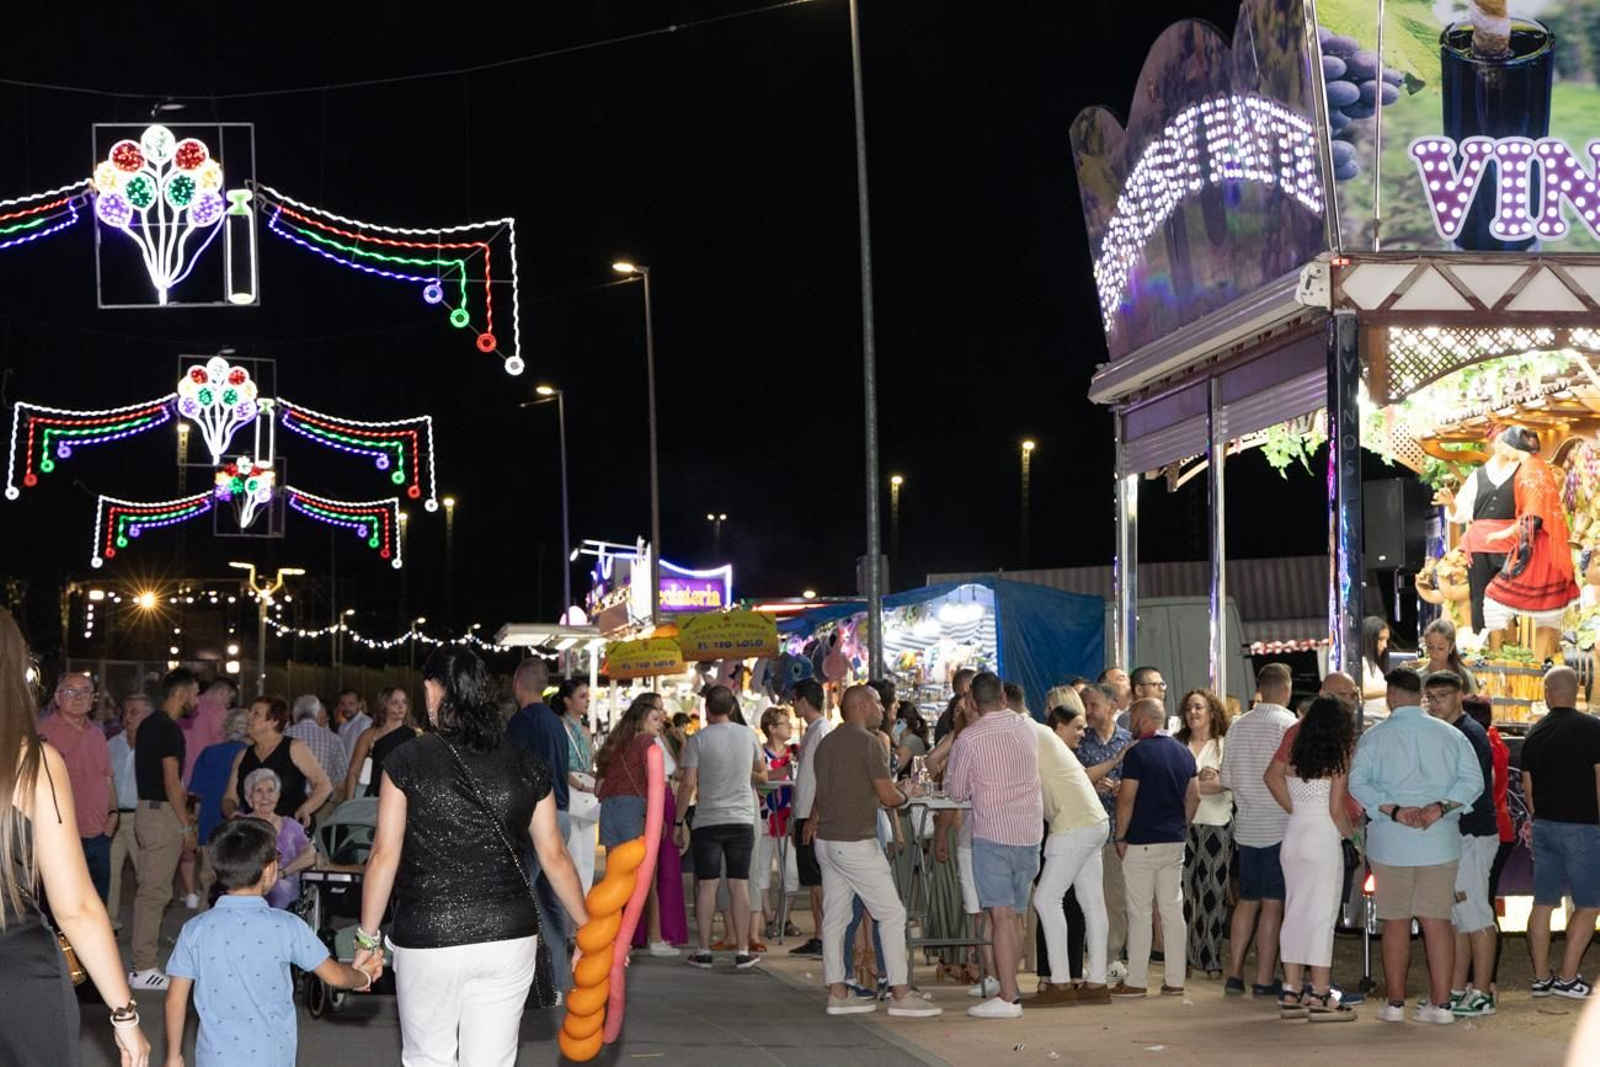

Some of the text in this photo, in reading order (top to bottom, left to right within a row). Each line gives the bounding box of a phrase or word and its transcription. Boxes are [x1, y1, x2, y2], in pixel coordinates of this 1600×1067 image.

[1408, 135, 1600, 241] VIN
[1342, 357, 1357, 476] VINOS
[697, 642, 709, 650] EL
[736, 639, 764, 648] LOLO
